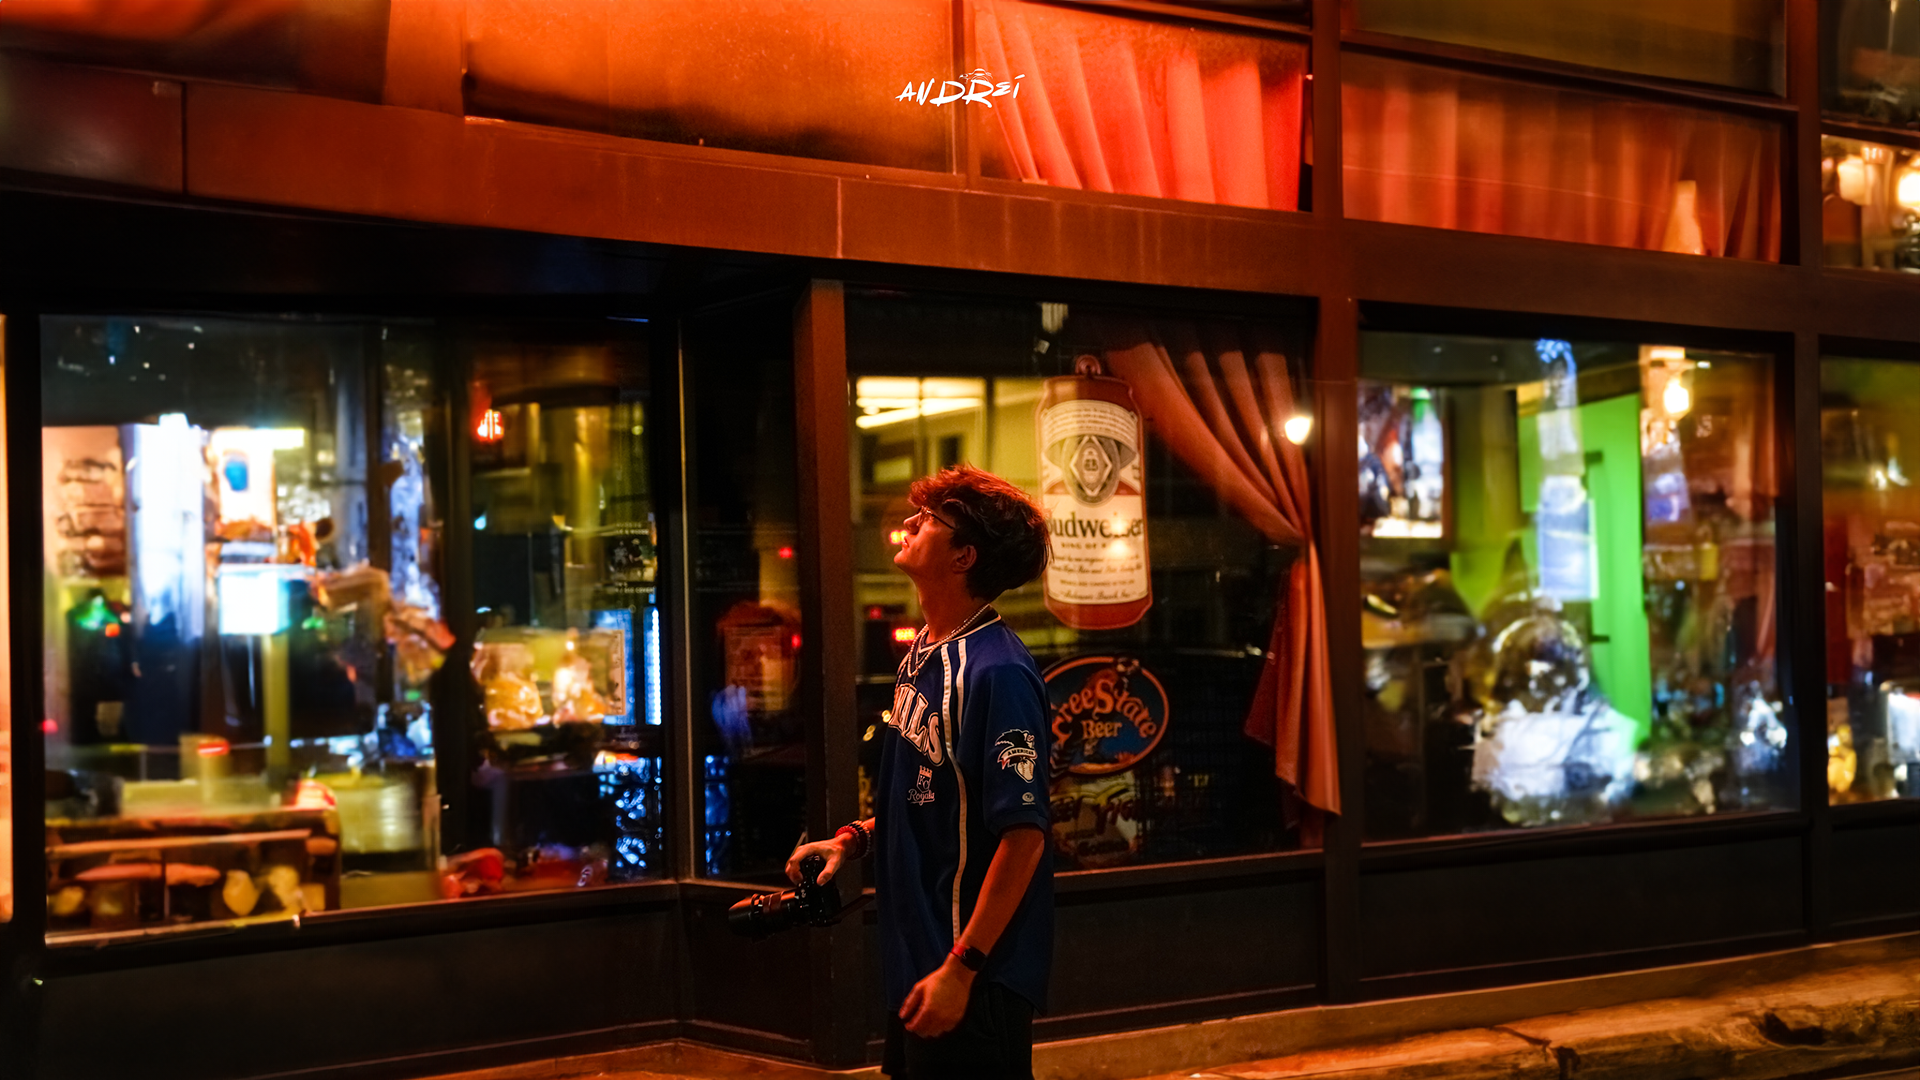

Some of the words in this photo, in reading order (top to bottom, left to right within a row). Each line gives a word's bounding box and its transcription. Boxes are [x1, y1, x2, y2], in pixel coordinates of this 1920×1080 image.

[1080, 719, 1123, 739] Beer
[918, 775, 930, 790] KC
[907, 788, 935, 806] Royals
